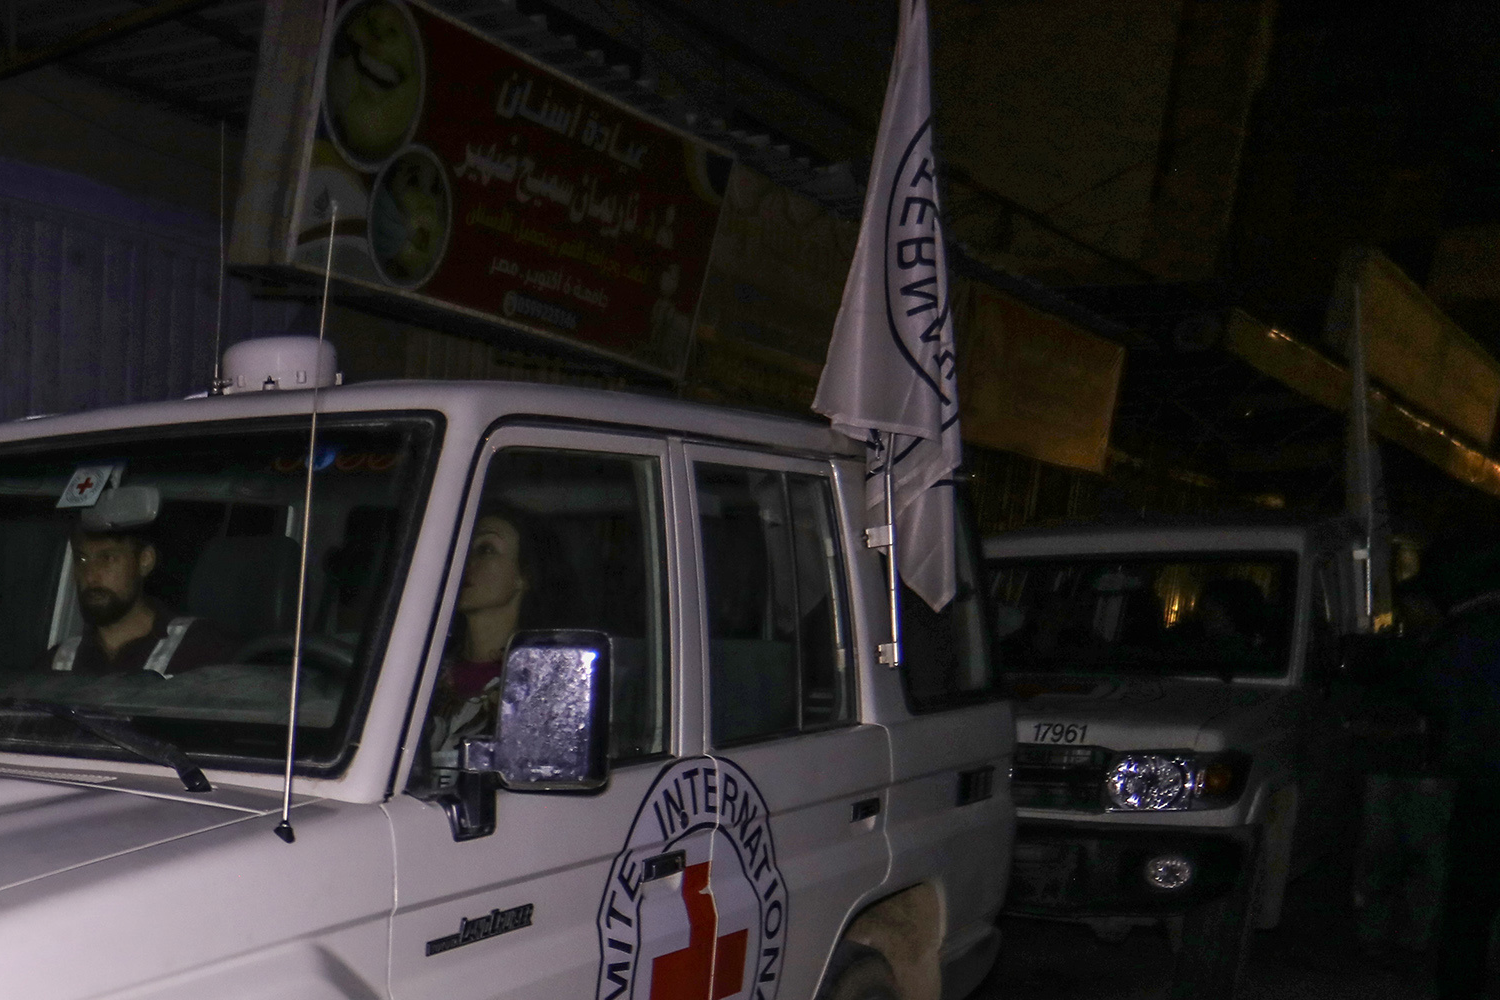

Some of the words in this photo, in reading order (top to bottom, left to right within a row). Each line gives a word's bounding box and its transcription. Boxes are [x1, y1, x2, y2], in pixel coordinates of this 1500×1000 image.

[581, 111, 650, 174] عيادة
[515, 156, 575, 207] سميح
[1033, 722, 1088, 743] 17961
